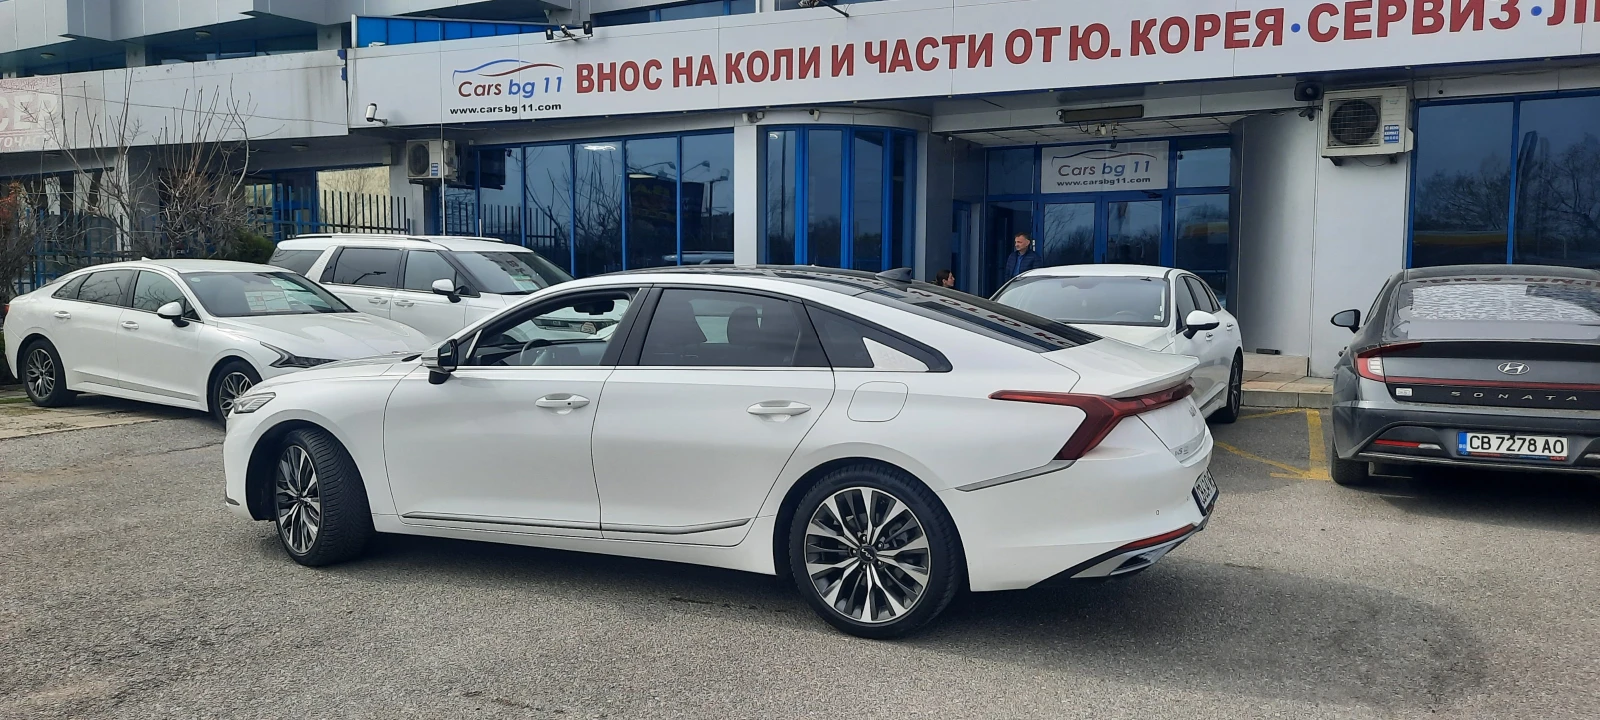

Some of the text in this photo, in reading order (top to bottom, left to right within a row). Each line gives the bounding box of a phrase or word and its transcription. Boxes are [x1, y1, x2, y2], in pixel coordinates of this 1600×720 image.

[577, 59, 662, 93] ВНОС
[673, 54, 717, 87] НА
[725, 46, 820, 84] КОЛИ
[831, 43, 854, 77] И
[865, 33, 993, 73] ЧАСТИ
[1005, 26, 1061, 64] ОТ
[1069, 23, 1121, 61] Ю.
[1130, 8, 1284, 56] КОРЕЯ
[1308, 0, 1520, 43] СЕРВИЗ
[458, 76, 563, 98] Cars bg 11
[1057, 160, 1150, 177] Cars bg 11
[1056, 177, 1151, 187] www.carsbg11.com
[1450, 391, 1578, 401] SONATA
[1495, 436, 1538, 453] 7278
